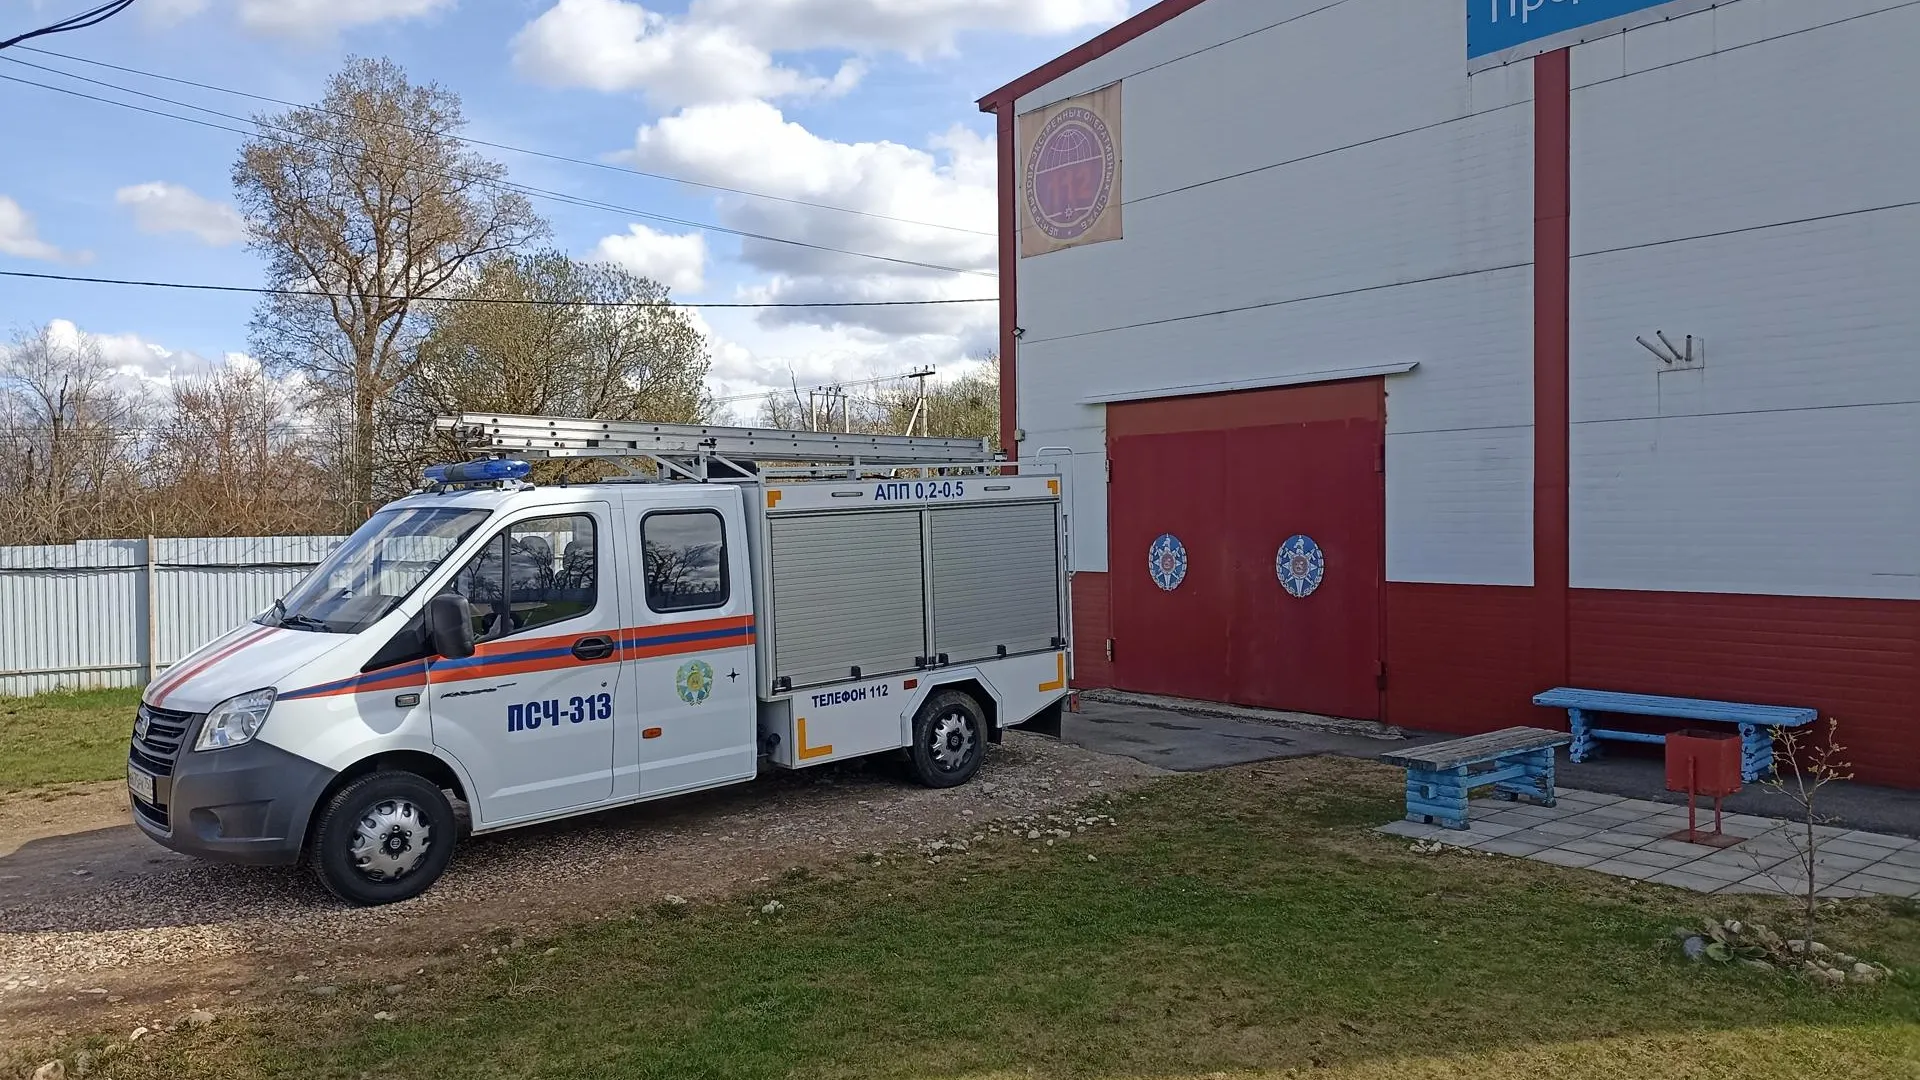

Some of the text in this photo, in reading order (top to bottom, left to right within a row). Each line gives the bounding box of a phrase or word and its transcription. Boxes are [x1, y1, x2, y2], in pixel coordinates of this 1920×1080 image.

[1031, 109, 1082, 159] ЭКСТРЕННЫХ
[1083, 111, 1114, 190] ОПЕРАТИВНЫХ
[875, 481, 964, 501] АПП 0,2-0,5
[507, 692, 612, 732] ПСЧ-313
[811, 684, 889, 709] ТЕЛЕФОН 112
